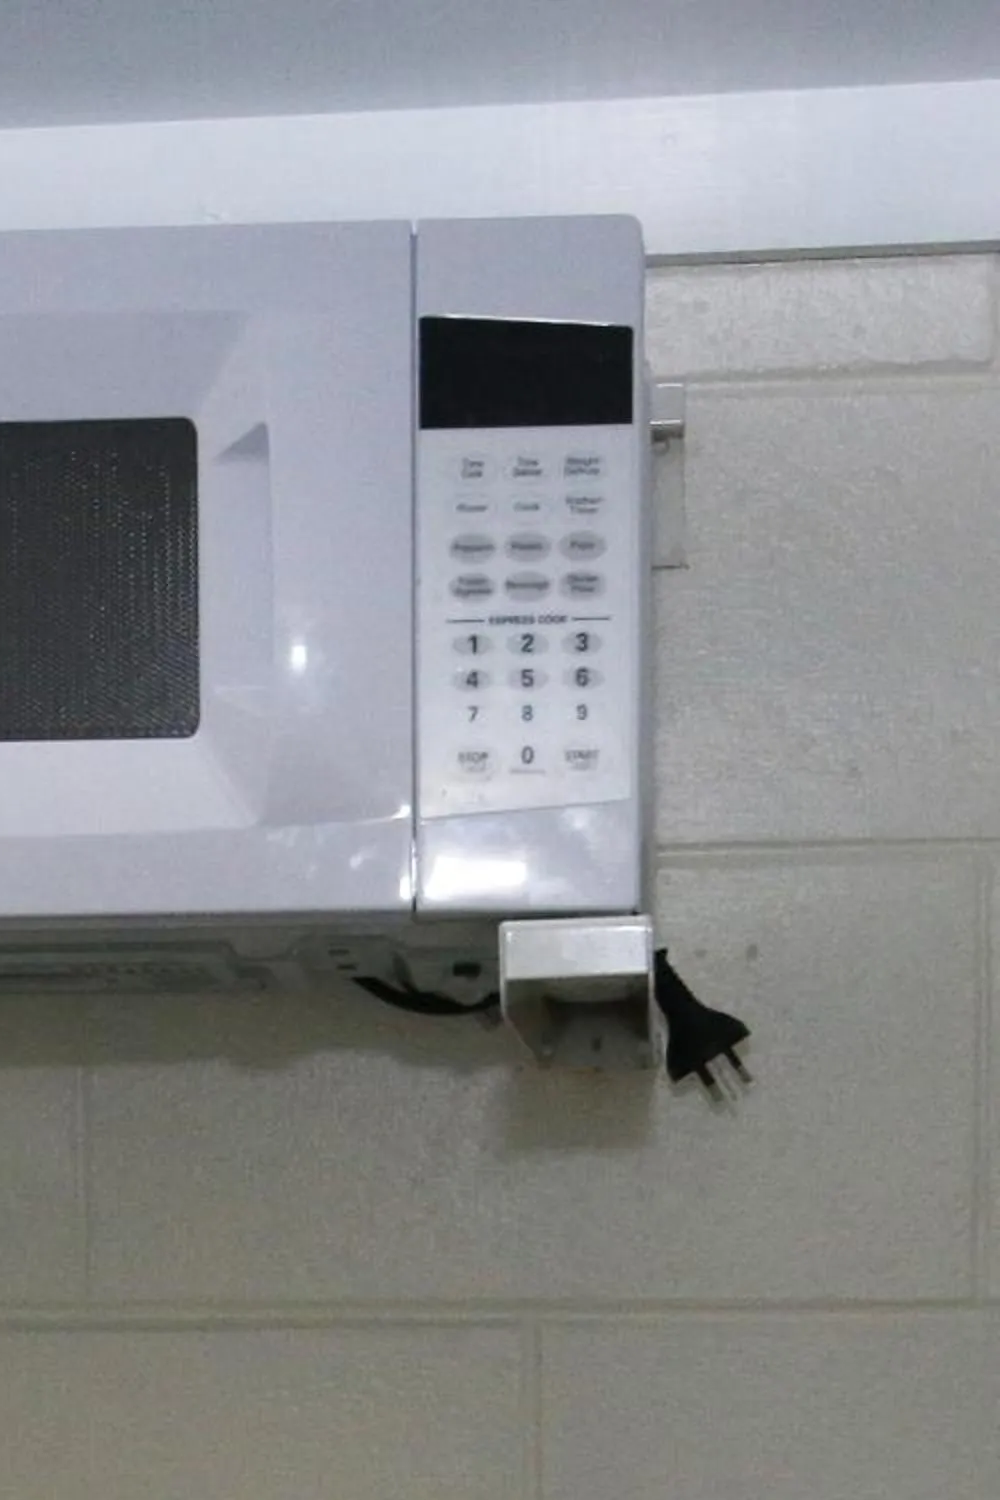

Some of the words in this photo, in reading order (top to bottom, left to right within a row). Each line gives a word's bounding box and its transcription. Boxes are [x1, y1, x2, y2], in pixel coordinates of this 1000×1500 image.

[468, 635, 478, 654] 1
[521, 633, 534, 653] 2
[575, 632, 588, 651] 3
[466, 671, 478, 688] 4
[521, 669, 534, 687] 5
[575, 667, 589, 687] 6
[468, 706, 478, 722] 7
[521, 705, 533, 721] 8
[576, 704, 587, 720] 9
[521, 746, 534, 764] 0
